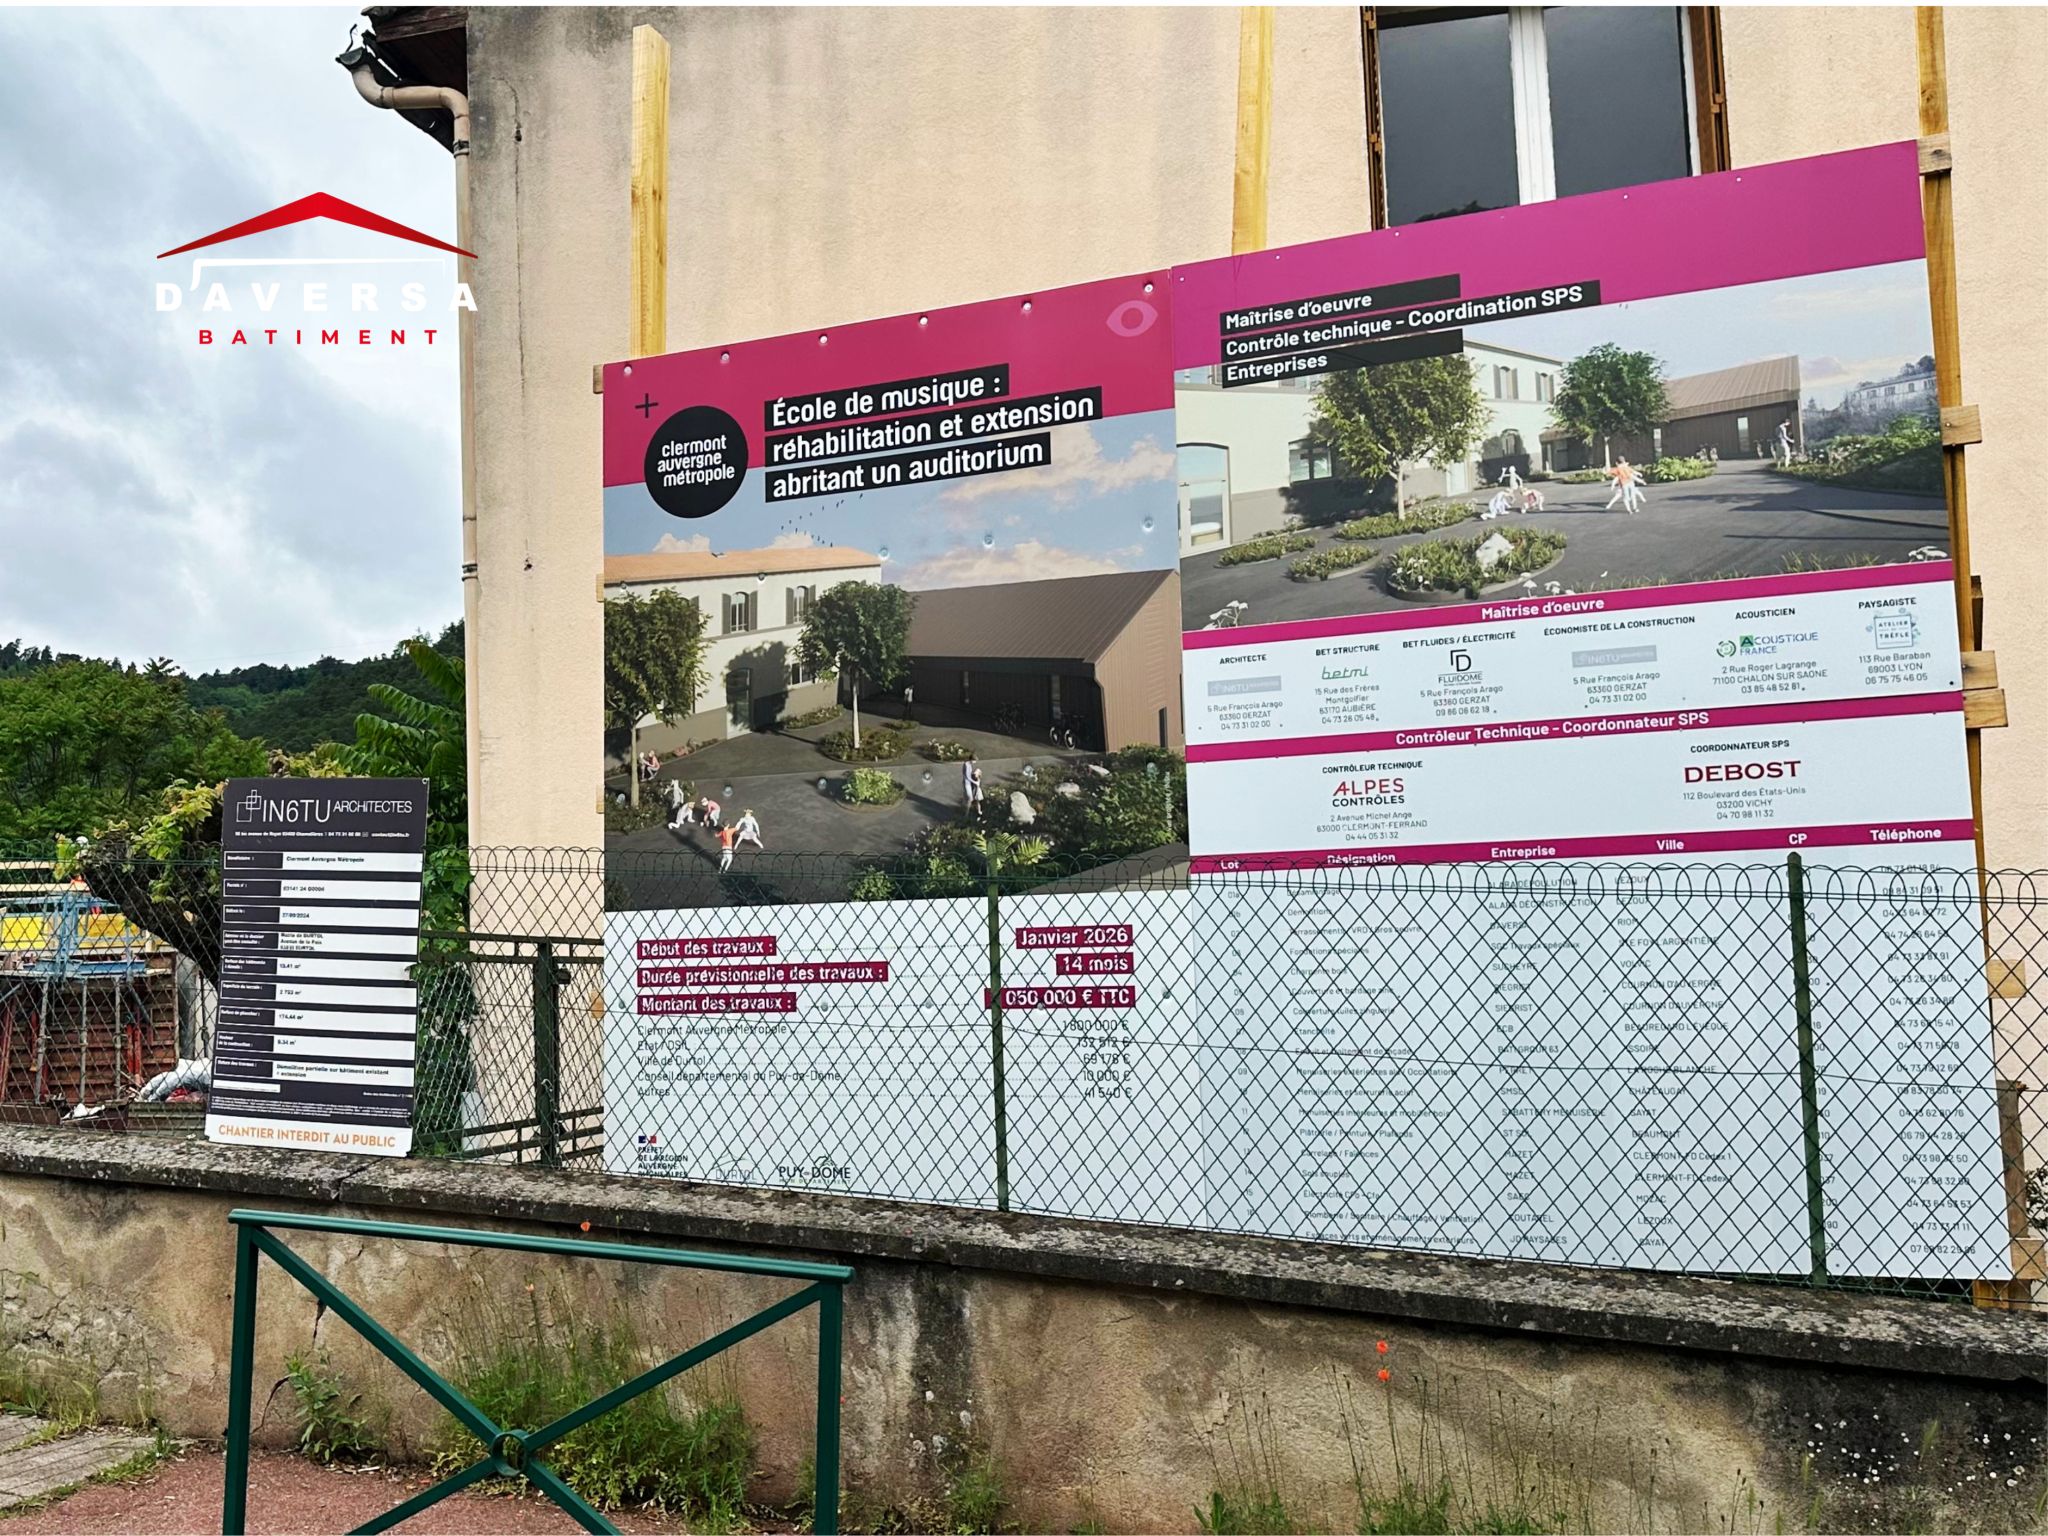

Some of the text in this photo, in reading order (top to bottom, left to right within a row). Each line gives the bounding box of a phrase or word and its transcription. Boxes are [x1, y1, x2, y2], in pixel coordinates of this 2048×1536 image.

[1226, 307, 1293, 330] Maîtrise
[1226, 331, 1299, 356] Contrôle
[1303, 317, 1392, 343] technique
[1408, 295, 1536, 327] Coordination
[1541, 285, 1583, 306] SPS
[1227, 353, 1327, 381] Entreprises
[772, 397, 837, 428] École
[845, 391, 873, 416] de
[881, 377, 984, 411] musique
[772, 396, 1095, 462] réhabilitation et extension
[661, 435, 727, 458] clermont
[657, 451, 722, 472] auvergne
[772, 439, 1043, 498] abritant un auditorium
[663, 463, 735, 487] métropole
[1482, 603, 1539, 620] Maîtrise
[1858, 597, 1917, 609] PAYSAGISTE
[1735, 608, 1796, 620] ACOUSTICIEN
[1544, 616, 1696, 636] ÉCONOMISTE DE LA CONSTRUCTION
[1403, 640, 1418, 649] BET
[1420, 637, 1455, 647] FLUIDES
[1462, 631, 1516, 643] ÉLECTRICITÉ
[1739, 632, 1819, 648] ACOUSTIQUE
[1315, 644, 1381, 656] BET STRUCTURE
[1740, 645, 1777, 656] FRANCE
[1873, 654, 1891, 662] Rue
[1893, 652, 1931, 661] Baraban
[1219, 654, 1267, 665] ARCHITECTE
[1722, 660, 1817, 674] 2 Rue Roger Lagrange
[1898, 662, 1923, 671] LYON
[1580, 676, 1596, 684] Rue
[1598, 673, 1634, 683] François
[1635, 671, 1660, 681] Arago
[1737, 673, 1775, 683] CHALON
[1776, 672, 1795, 680] SUR
[1396, 730, 1471, 746] Contrôleur
[1474, 724, 1549, 742] Technique
[1562, 714, 1675, 734] Coordonnateur
[1678, 712, 1710, 725] SPS
[1690, 740, 1790, 753] COORDONNATEUR SPS
[1322, 761, 1423, 774] CONTRÔLEUR TECHNIQUE
[1684, 760, 1802, 783] DEBOST
[1333, 778, 1404, 796] ALPES
[1697, 789, 1740, 799] Boulevard
[1741, 789, 1758, 797] des
[1759, 786, 1806, 796] États-Unis
[1332, 794, 1405, 807] CONTRÔLES
[1746, 799, 1773, 808] VICHY
[263, 799, 413, 823] IN6TU ARCHITECTES
[1336, 813, 1365, 821] Avenue
[1221, 828, 1942, 869] Lot Désignation Entreprise Ville CP Téléphone
[1021, 927, 1128, 945] Janvier 2026
[642, 941, 680, 956] Début
[684, 940, 707, 955] des
[712, 939, 764, 955] travaux
[1063, 954, 1129, 972] 14 mois
[642, 969, 680, 984] Durée
[685, 965, 784, 986] prévisionnelle
[790, 964, 815, 980] des
[819, 964, 873, 980] travaux
[642, 996, 697, 1012] Montant
[702, 995, 726, 1010] des
[730, 994, 782, 1010] travaux
[1044, 988, 1076, 1005] 000
[219, 1124, 396, 1147] CHANTIER INTERDIT AU PUBLIC
